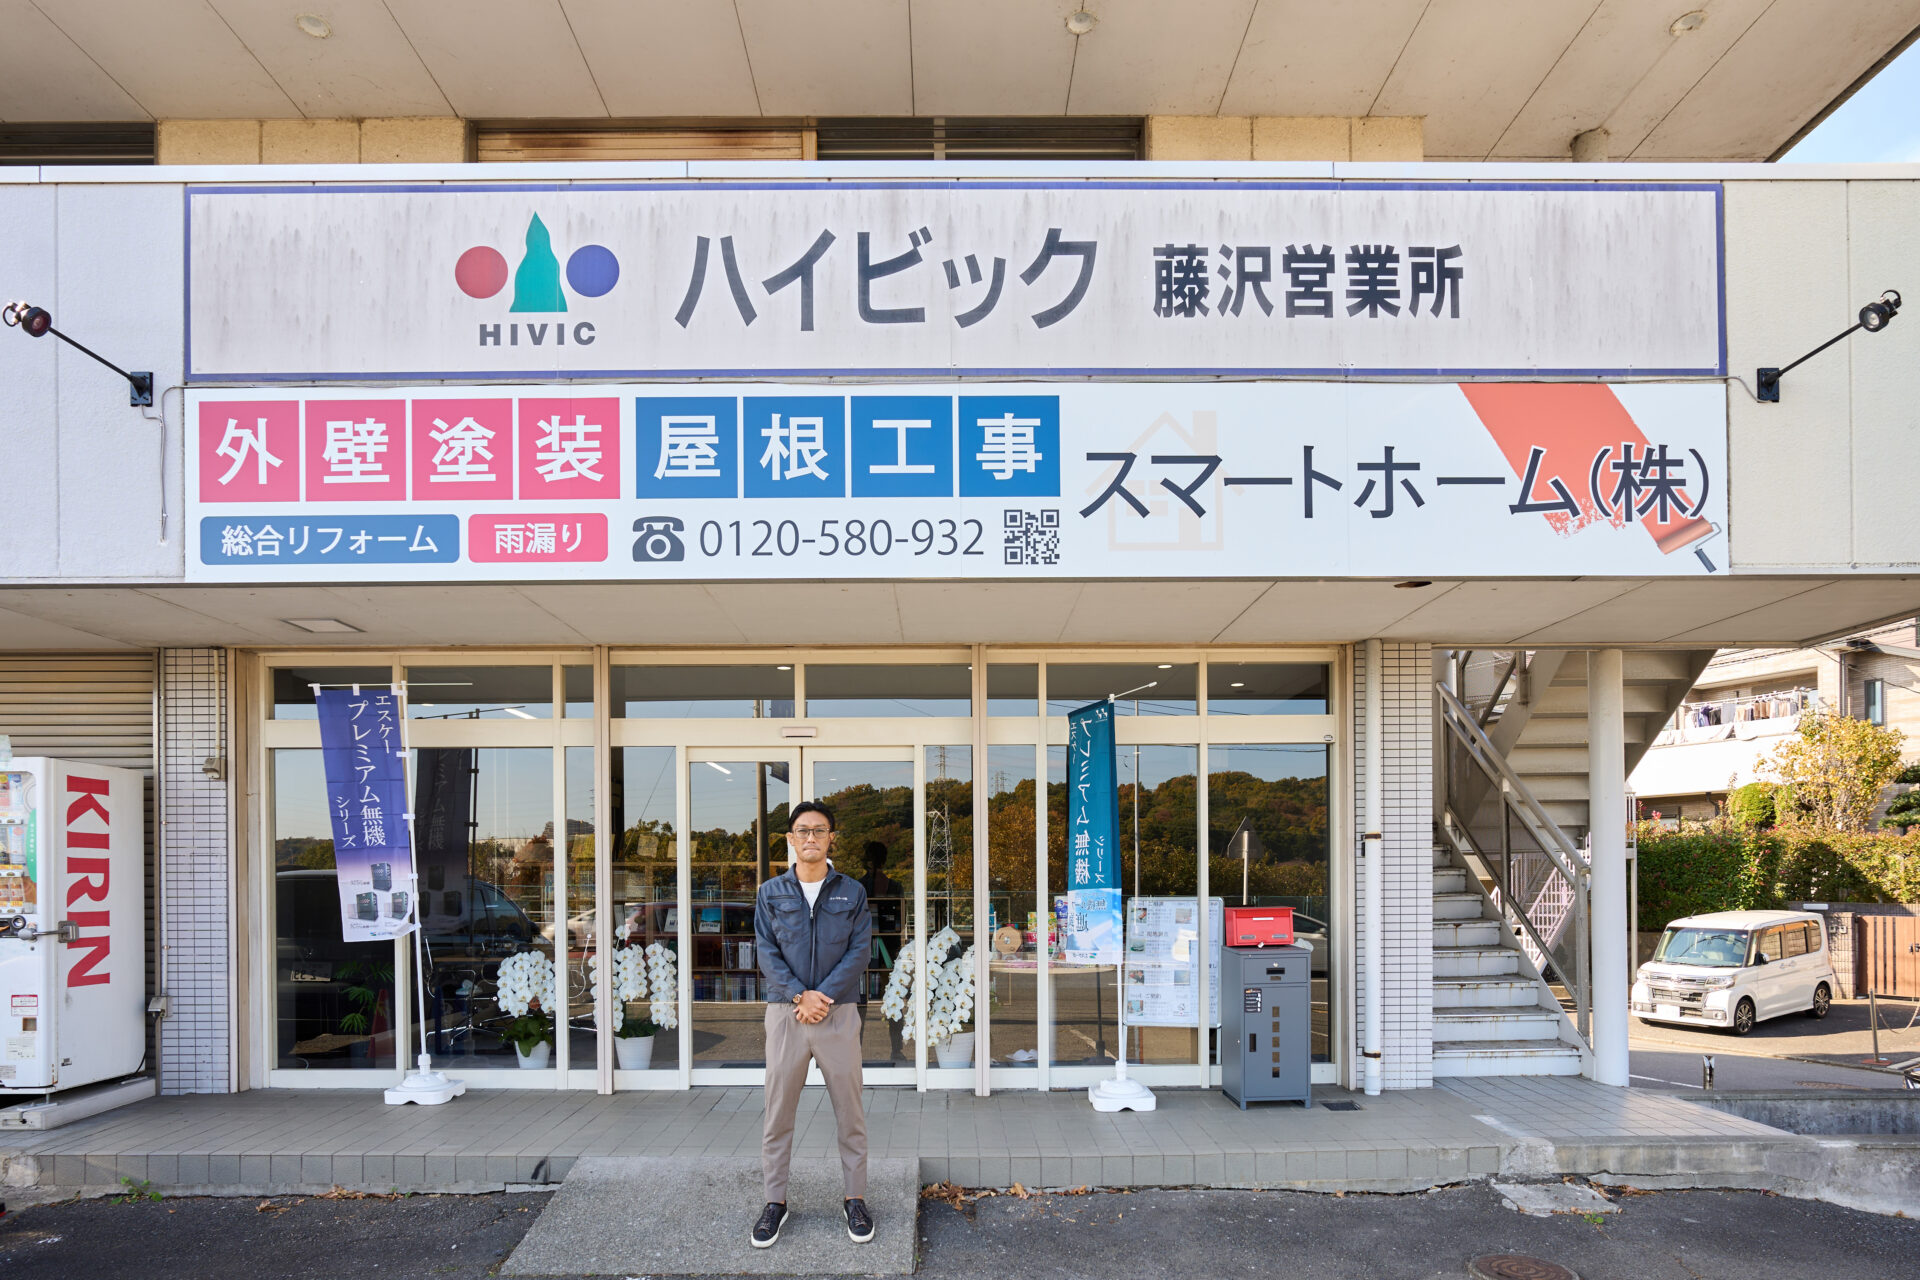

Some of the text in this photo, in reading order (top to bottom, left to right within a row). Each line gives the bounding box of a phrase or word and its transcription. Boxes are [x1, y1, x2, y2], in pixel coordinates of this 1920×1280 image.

[675, 227, 1464, 332] ハイビック 藤沢営業所
[480, 322, 595, 346] HIVIC
[215, 413, 1043, 486] 外壁塗装 屋根工事
[220, 524, 438, 557] 総合リフォーム
[493, 522, 583, 554] 雨漏り
[701, 520, 984, 557] 0120-580-932
[375, 695, 394, 755] エスケー
[347, 700, 387, 848] プレミアム無機
[336, 795, 358, 850] シリーズ
[67, 776, 111, 988] KIRIN
